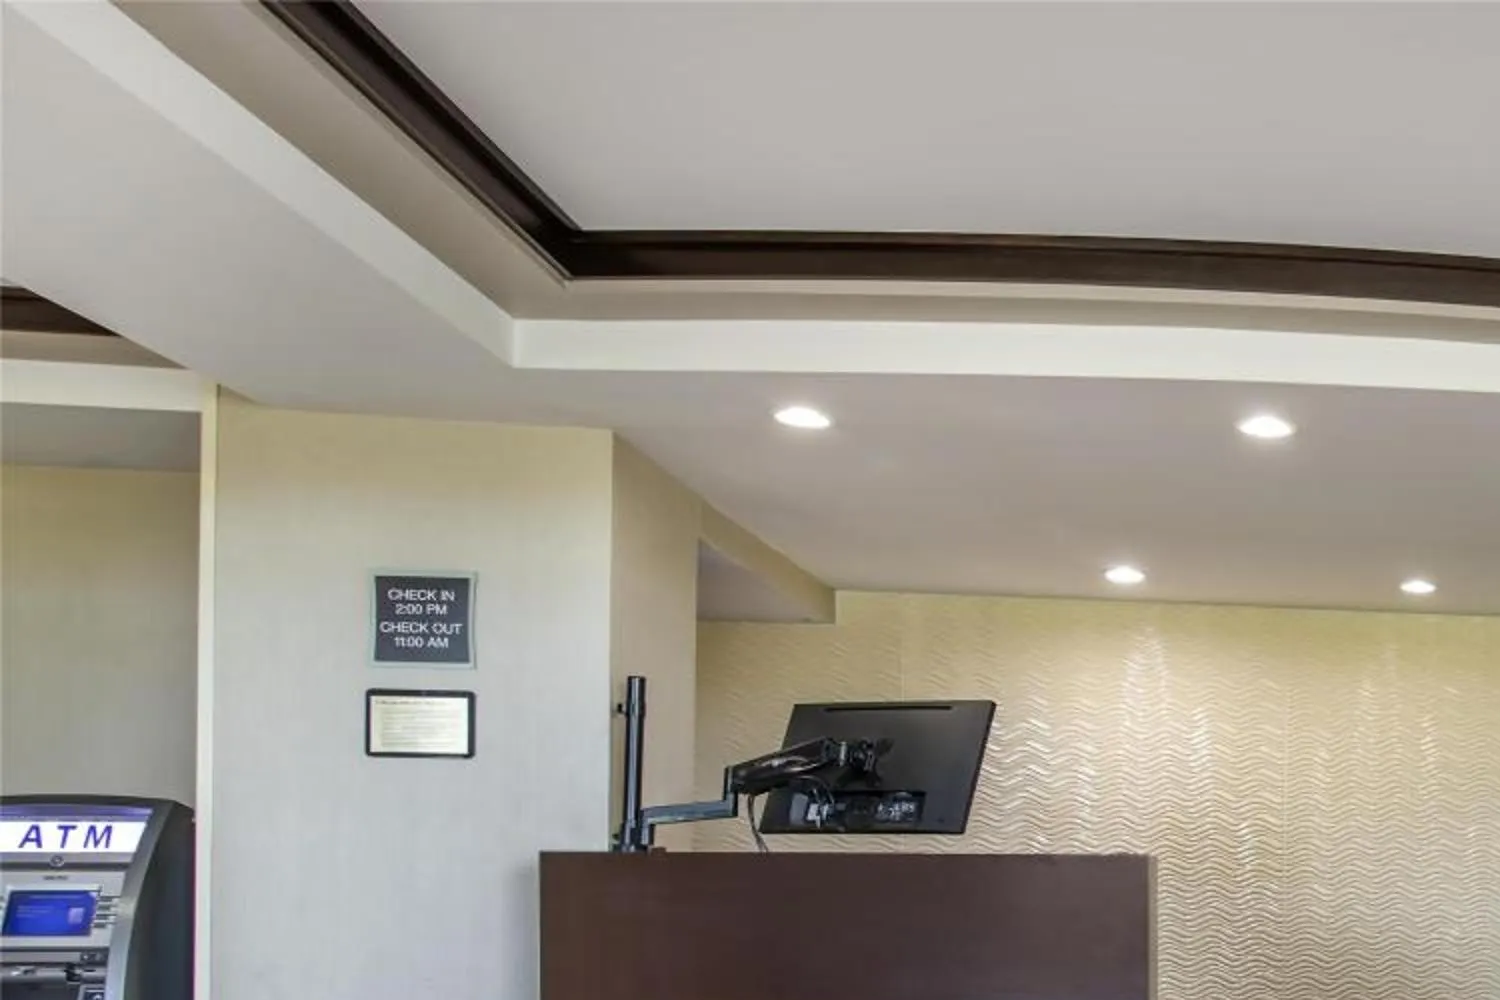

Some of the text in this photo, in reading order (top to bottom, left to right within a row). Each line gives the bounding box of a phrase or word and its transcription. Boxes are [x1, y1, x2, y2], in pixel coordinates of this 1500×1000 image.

[388, 589, 455, 601] CHECK IN
[395, 603, 447, 615] 2:00 PM
[380, 621, 463, 634] CHECK OUT
[394, 636, 449, 648] 11:00 AM
[19, 824, 113, 849] ATM
